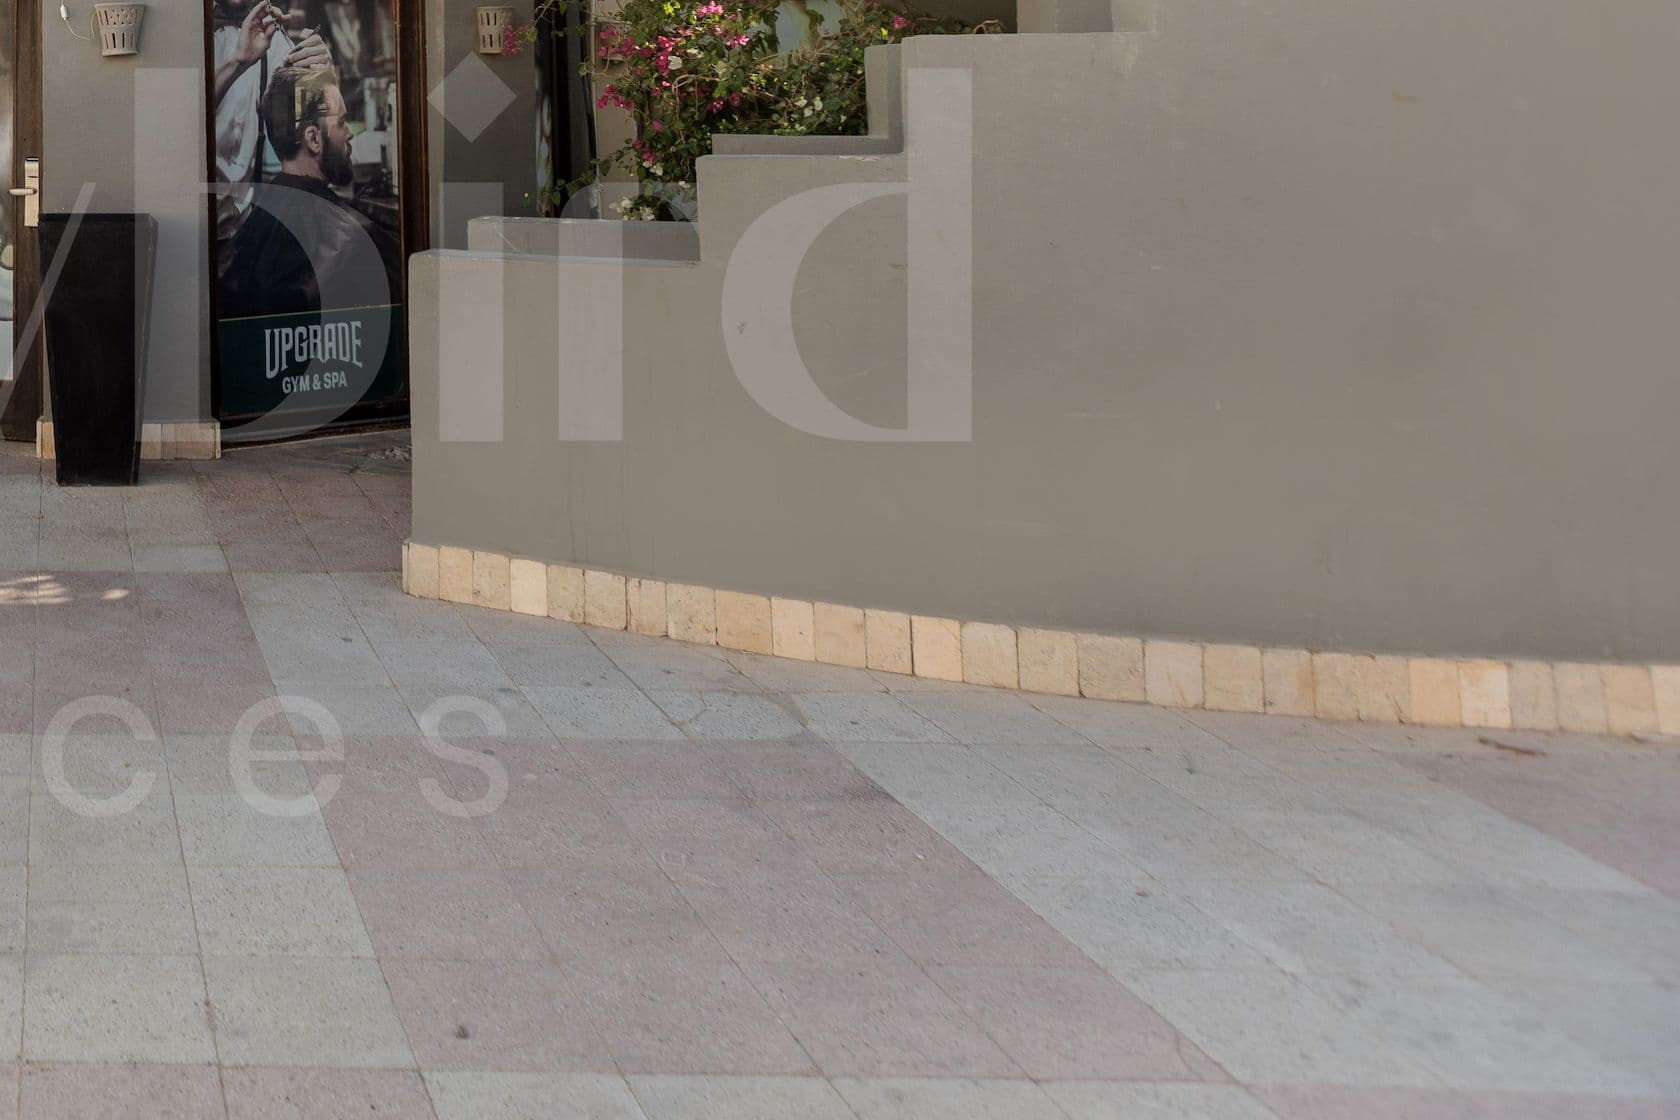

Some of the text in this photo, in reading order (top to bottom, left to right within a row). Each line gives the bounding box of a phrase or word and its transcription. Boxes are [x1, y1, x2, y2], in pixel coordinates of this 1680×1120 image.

[264, 320, 363, 379] UPGRADE
[282, 372, 348, 394] GYM & SPA
